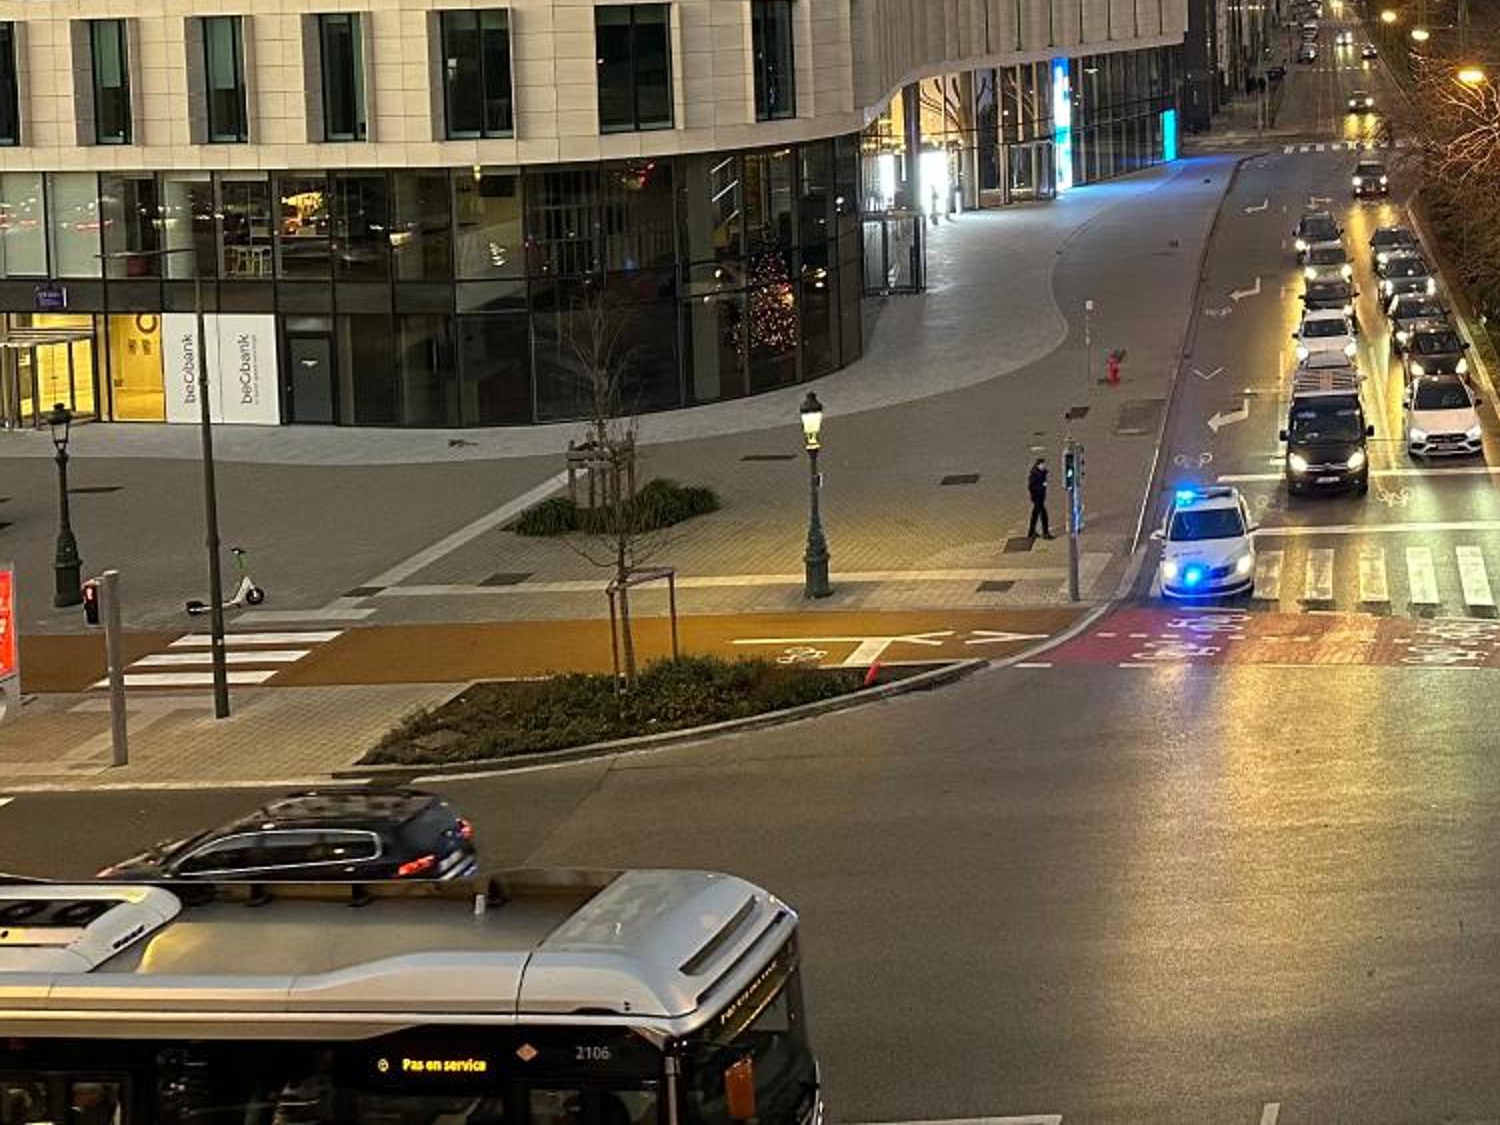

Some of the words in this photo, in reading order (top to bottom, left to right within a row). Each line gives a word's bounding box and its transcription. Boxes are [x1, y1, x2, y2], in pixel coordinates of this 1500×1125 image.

[575, 1046, 610, 1060] 2106
[402, 1058, 424, 1072] Pas
[426, 1060, 442, 1072] en
[444, 1058, 487, 1072] service
